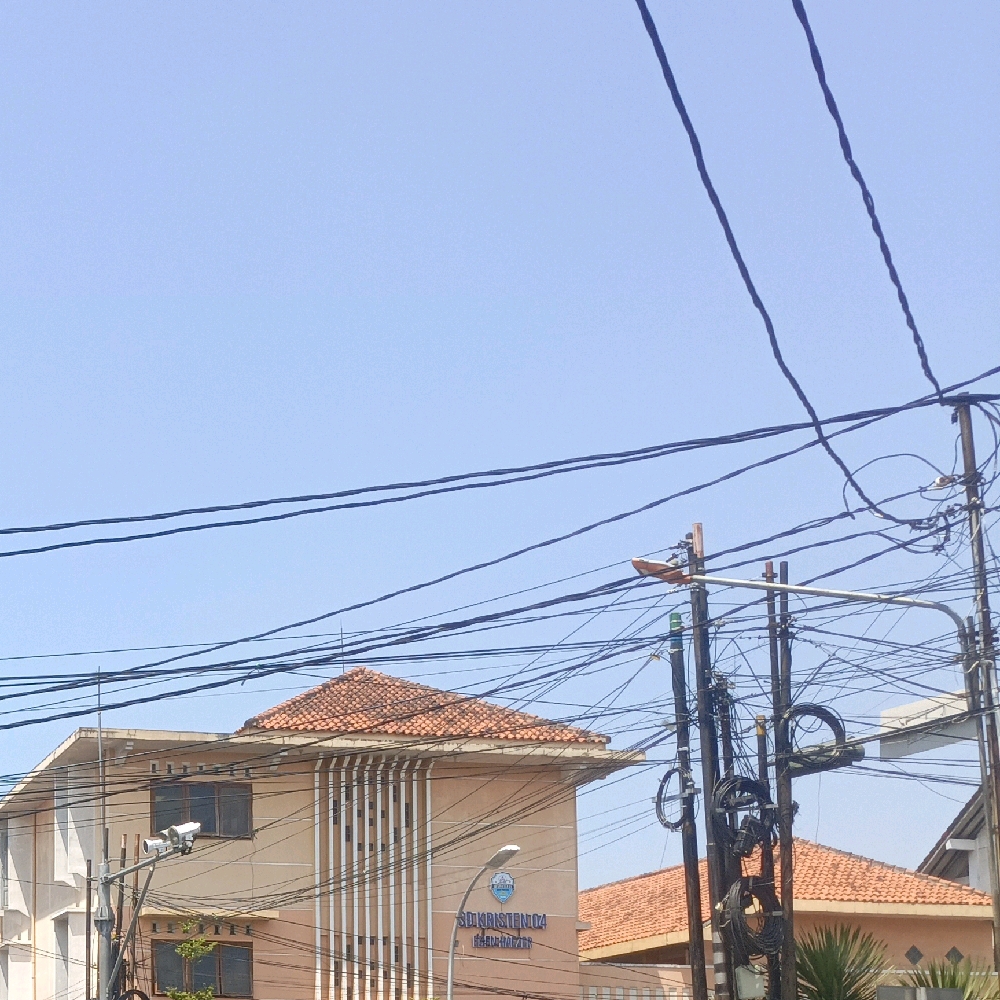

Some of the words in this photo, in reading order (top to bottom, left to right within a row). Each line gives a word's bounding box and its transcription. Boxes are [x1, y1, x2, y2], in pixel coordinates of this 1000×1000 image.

[458, 911, 474, 928] SD
[476, 911, 530, 929] KRISTEN
[532, 913, 547, 930] 04
